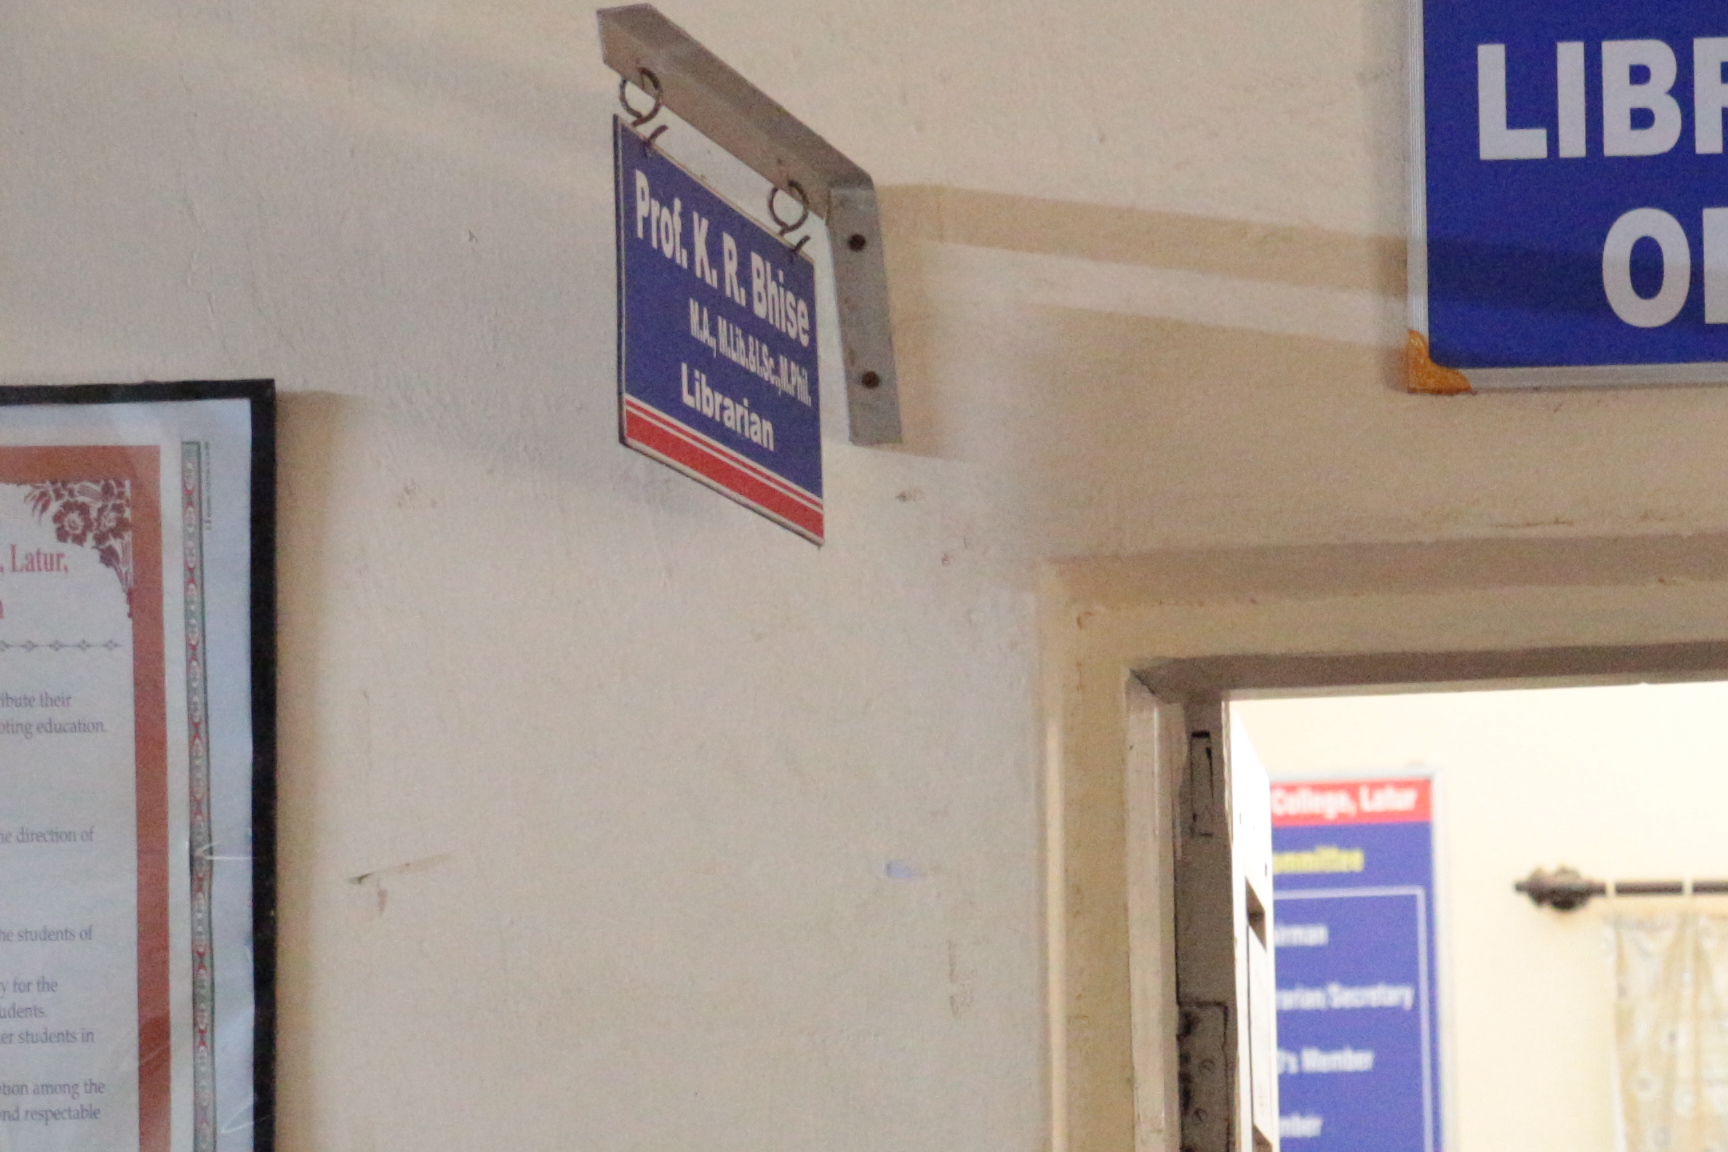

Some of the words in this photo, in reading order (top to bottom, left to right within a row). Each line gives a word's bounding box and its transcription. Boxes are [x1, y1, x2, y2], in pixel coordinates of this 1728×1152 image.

[635, 168, 688, 270] Prof.
[693, 211, 718, 290] K.
[722, 230, 747, 307] R.
[751, 251, 811, 347] Bhise
[681, 362, 776, 452] Librarian
[40, 691, 72, 707] their
[36, 718, 107, 734] education.
[16, 827, 77, 843] direction
[80, 826, 95, 842] of
[18, 925, 76, 941] students
[79, 924, 94, 940] of
[13, 976, 32, 993] for
[36, 976, 58, 992] the
[18, 1027, 77, 1043] students
[80, 1027, 95, 1042] in
[32, 1081, 80, 1100] among
[83, 1078, 106, 1094] the
[24, 1103, 101, 1126] respectable
